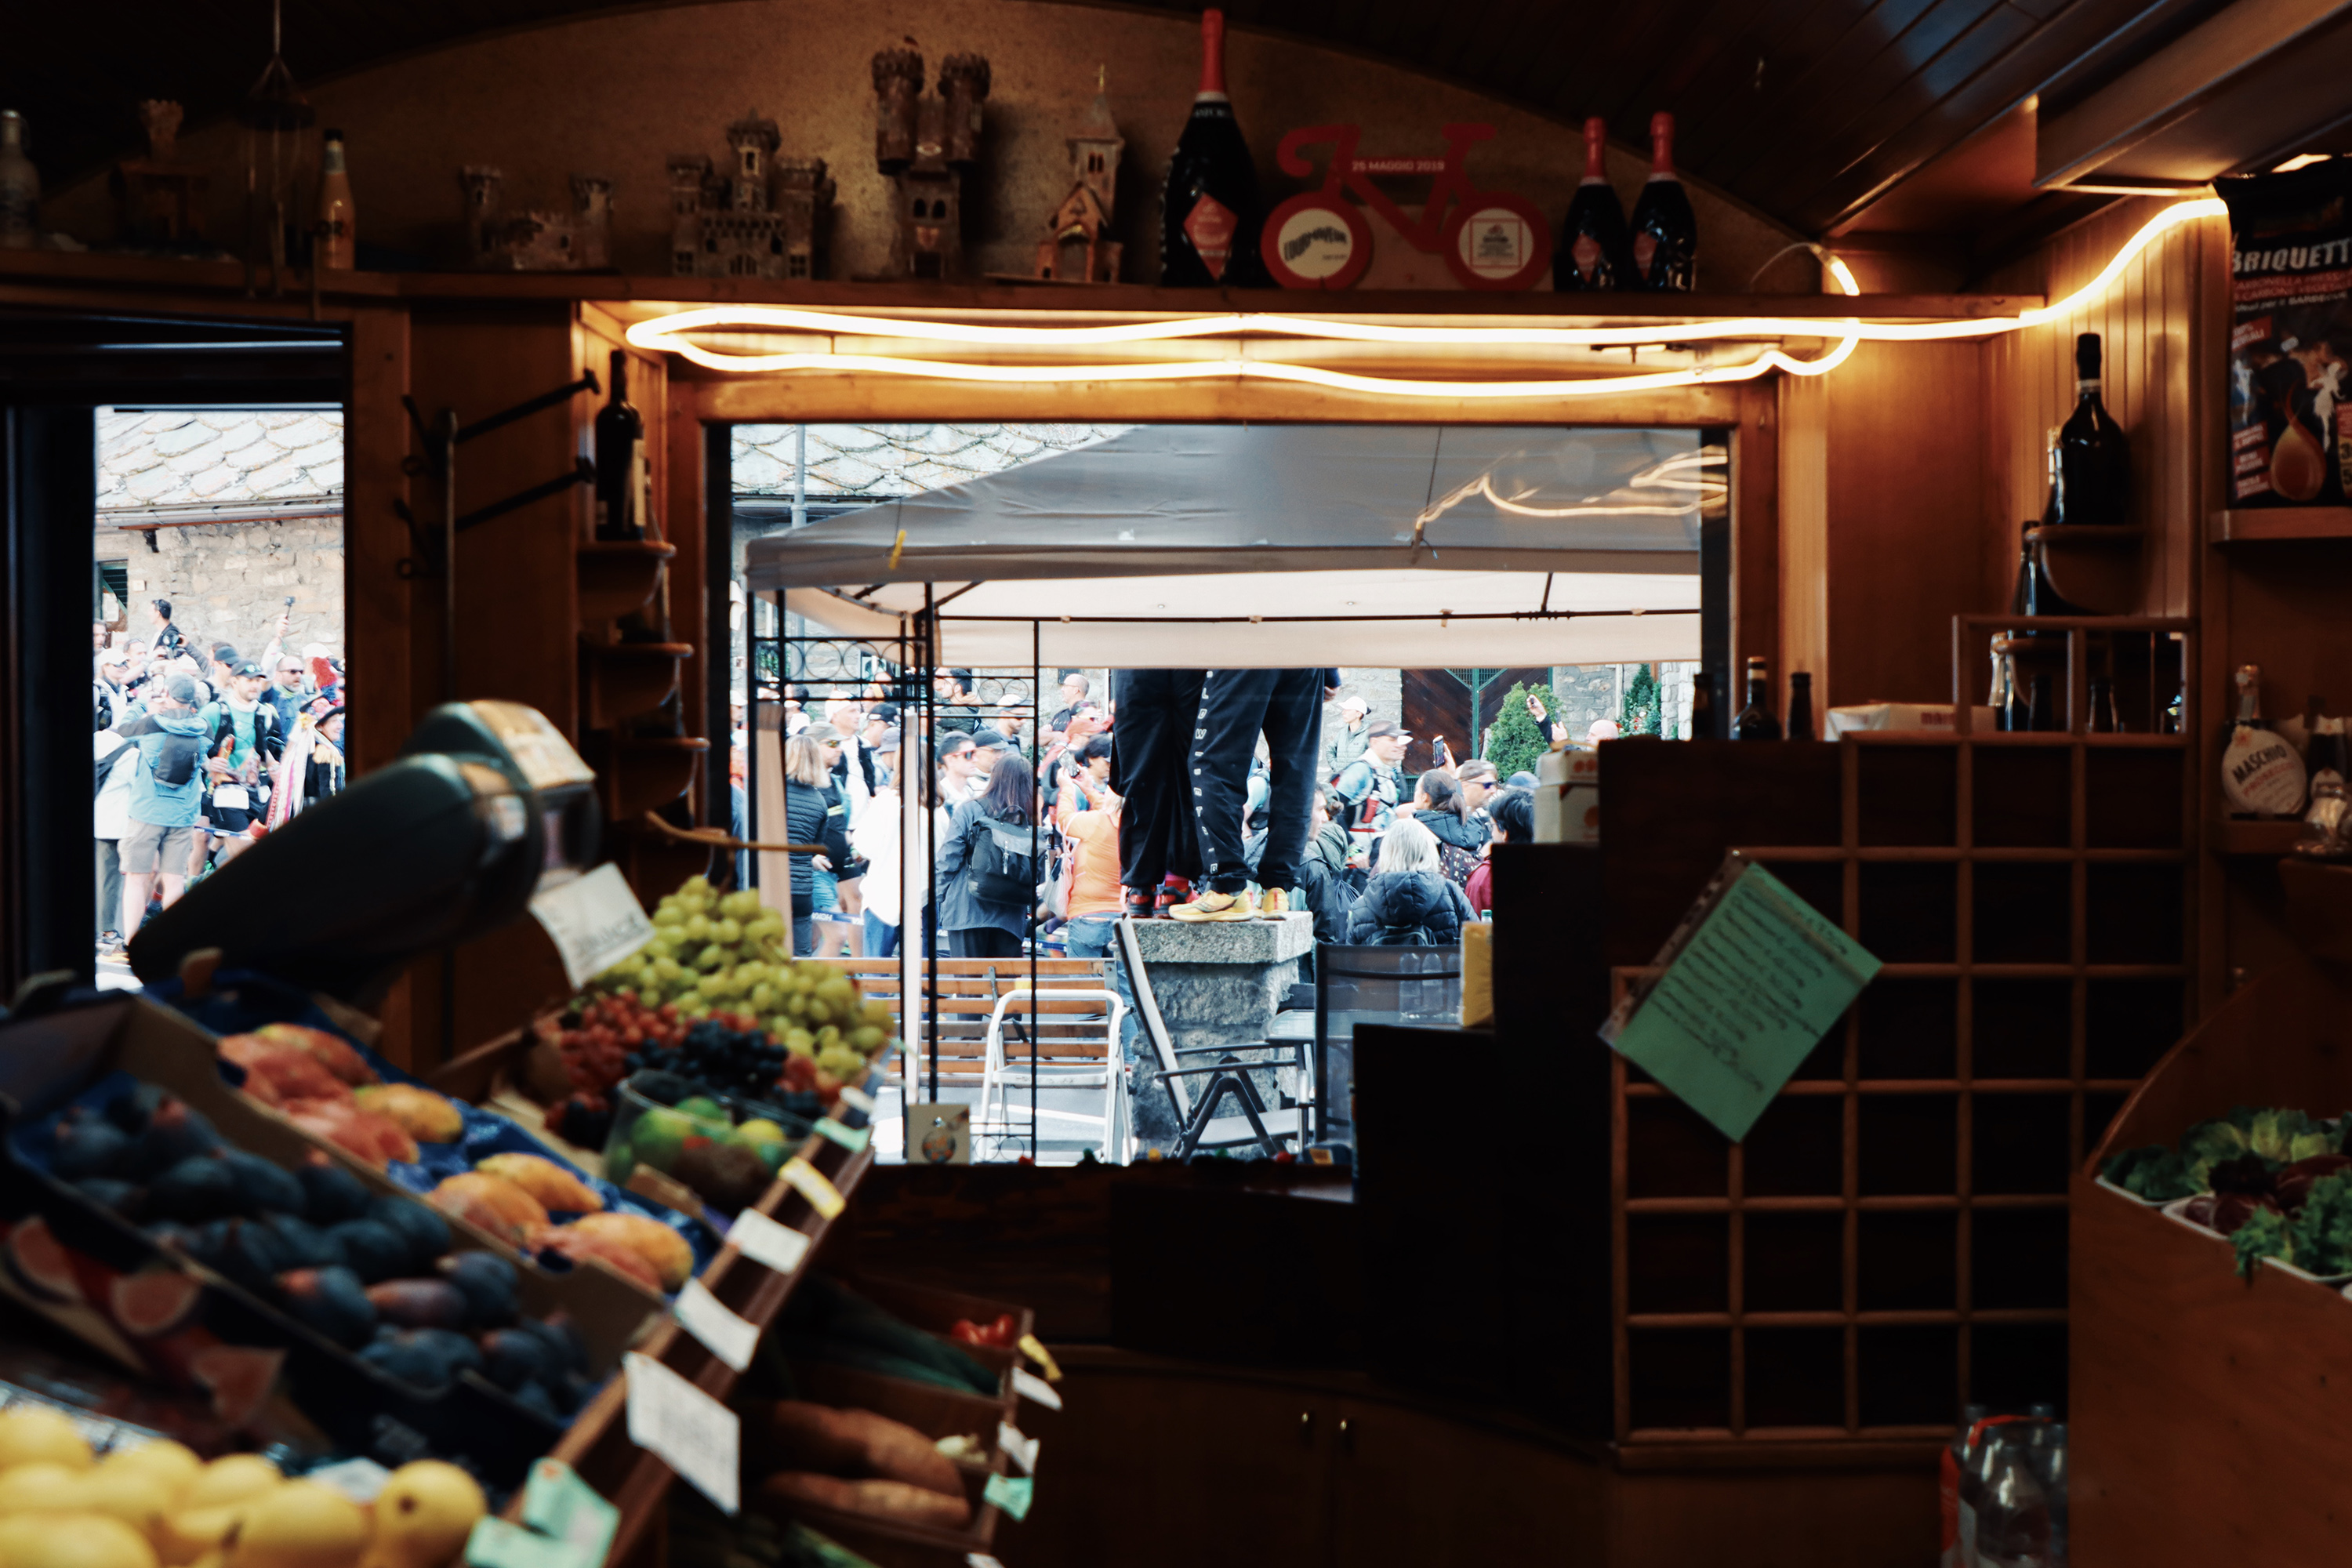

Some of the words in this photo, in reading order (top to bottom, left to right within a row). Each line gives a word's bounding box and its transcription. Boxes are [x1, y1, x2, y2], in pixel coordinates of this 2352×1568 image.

[1368, 160, 1414, 171] MAGGIO
[2234, 237, 2352, 273] BRIQUETT
[2233, 744, 2287, 784] MASCHIO
